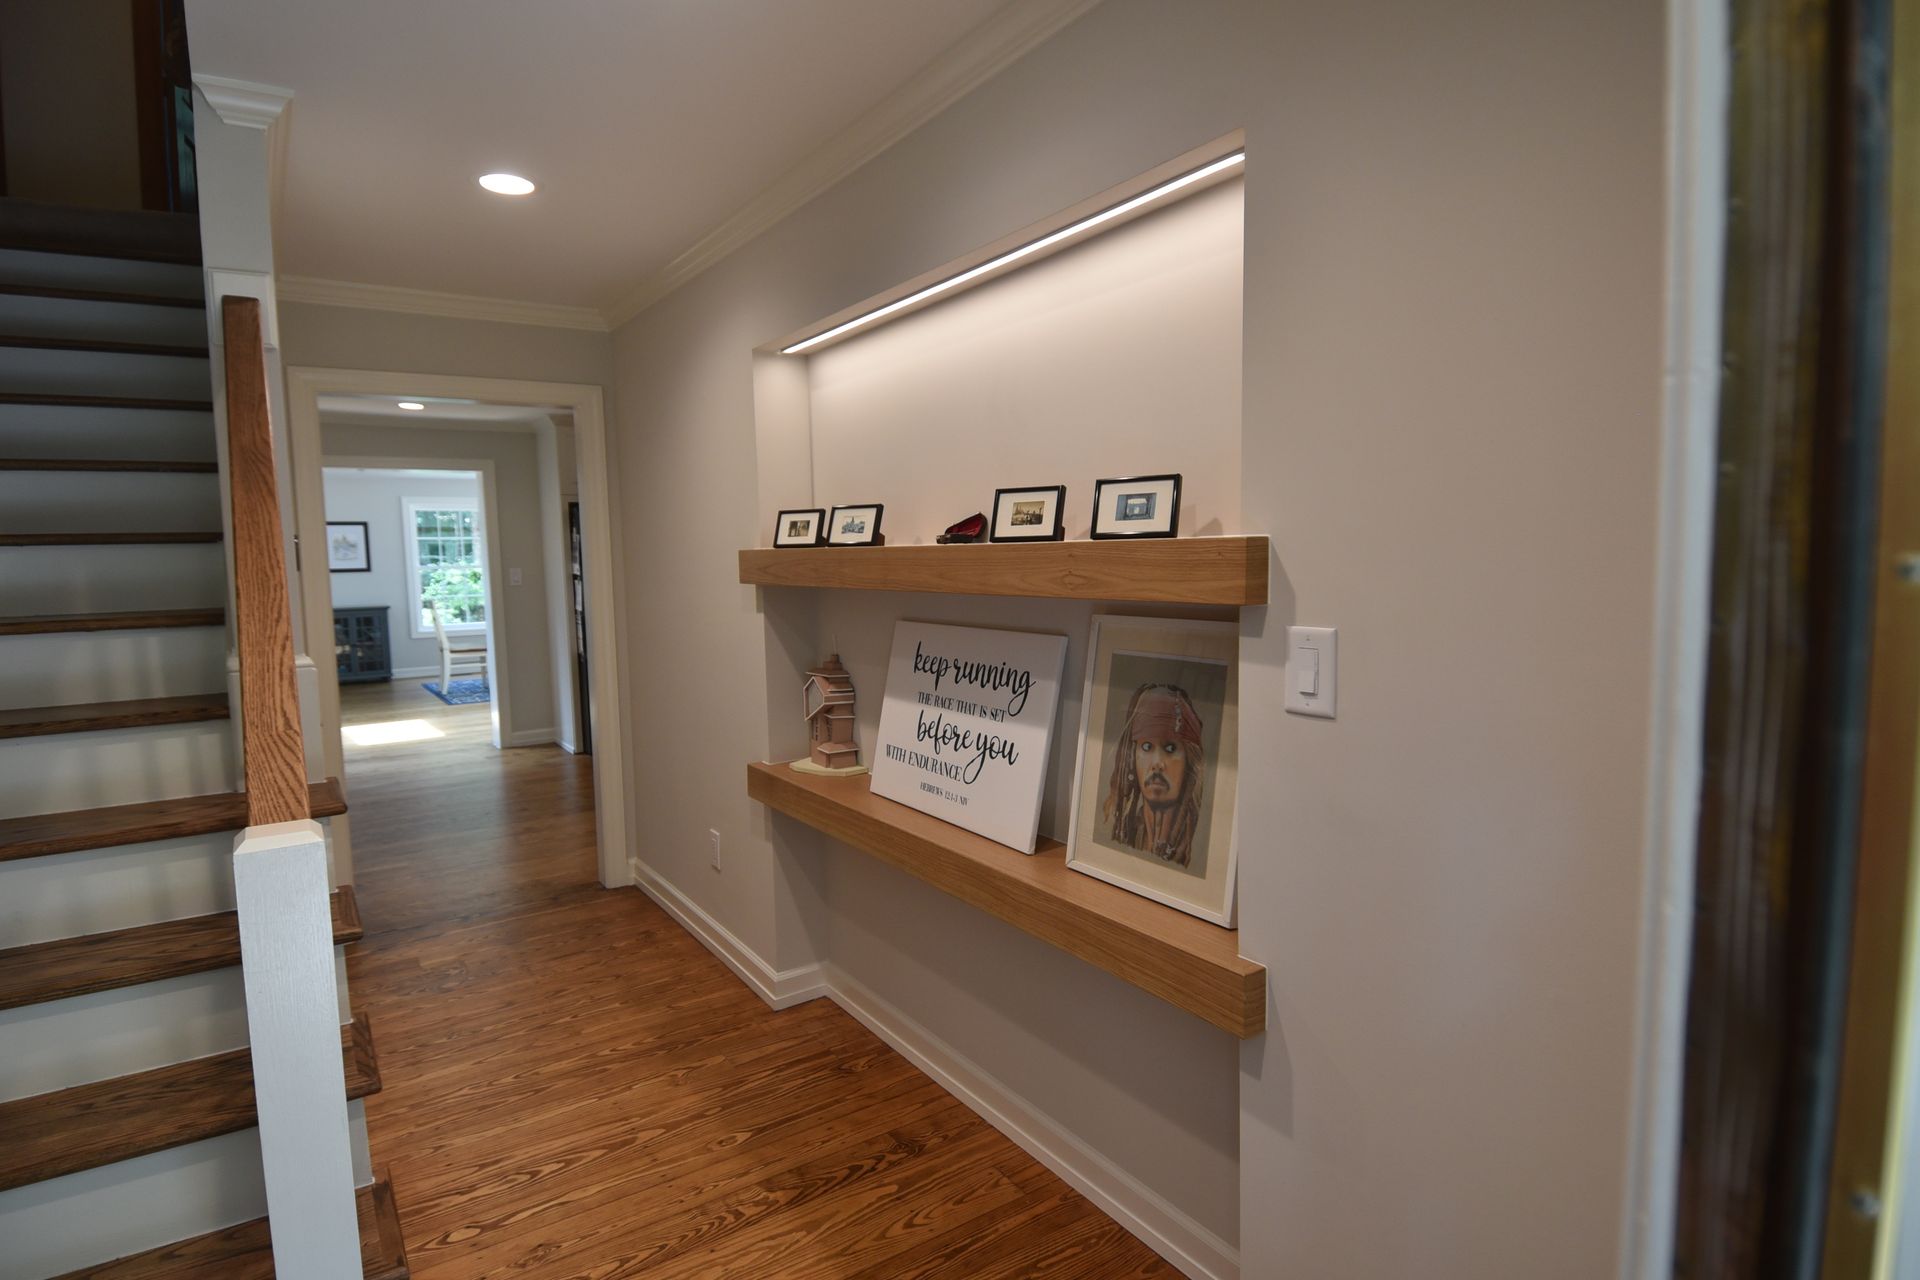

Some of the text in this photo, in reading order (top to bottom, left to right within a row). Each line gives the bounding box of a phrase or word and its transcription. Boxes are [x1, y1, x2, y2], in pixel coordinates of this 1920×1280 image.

[914, 641, 1036, 717] keep running
[918, 691, 1007, 723] THE RACE THAT IS SET
[886, 744, 963, 782] WITH ENDURANCE
[917, 709, 1019, 785] before you
[919, 781, 943, 796] HEBREWS
